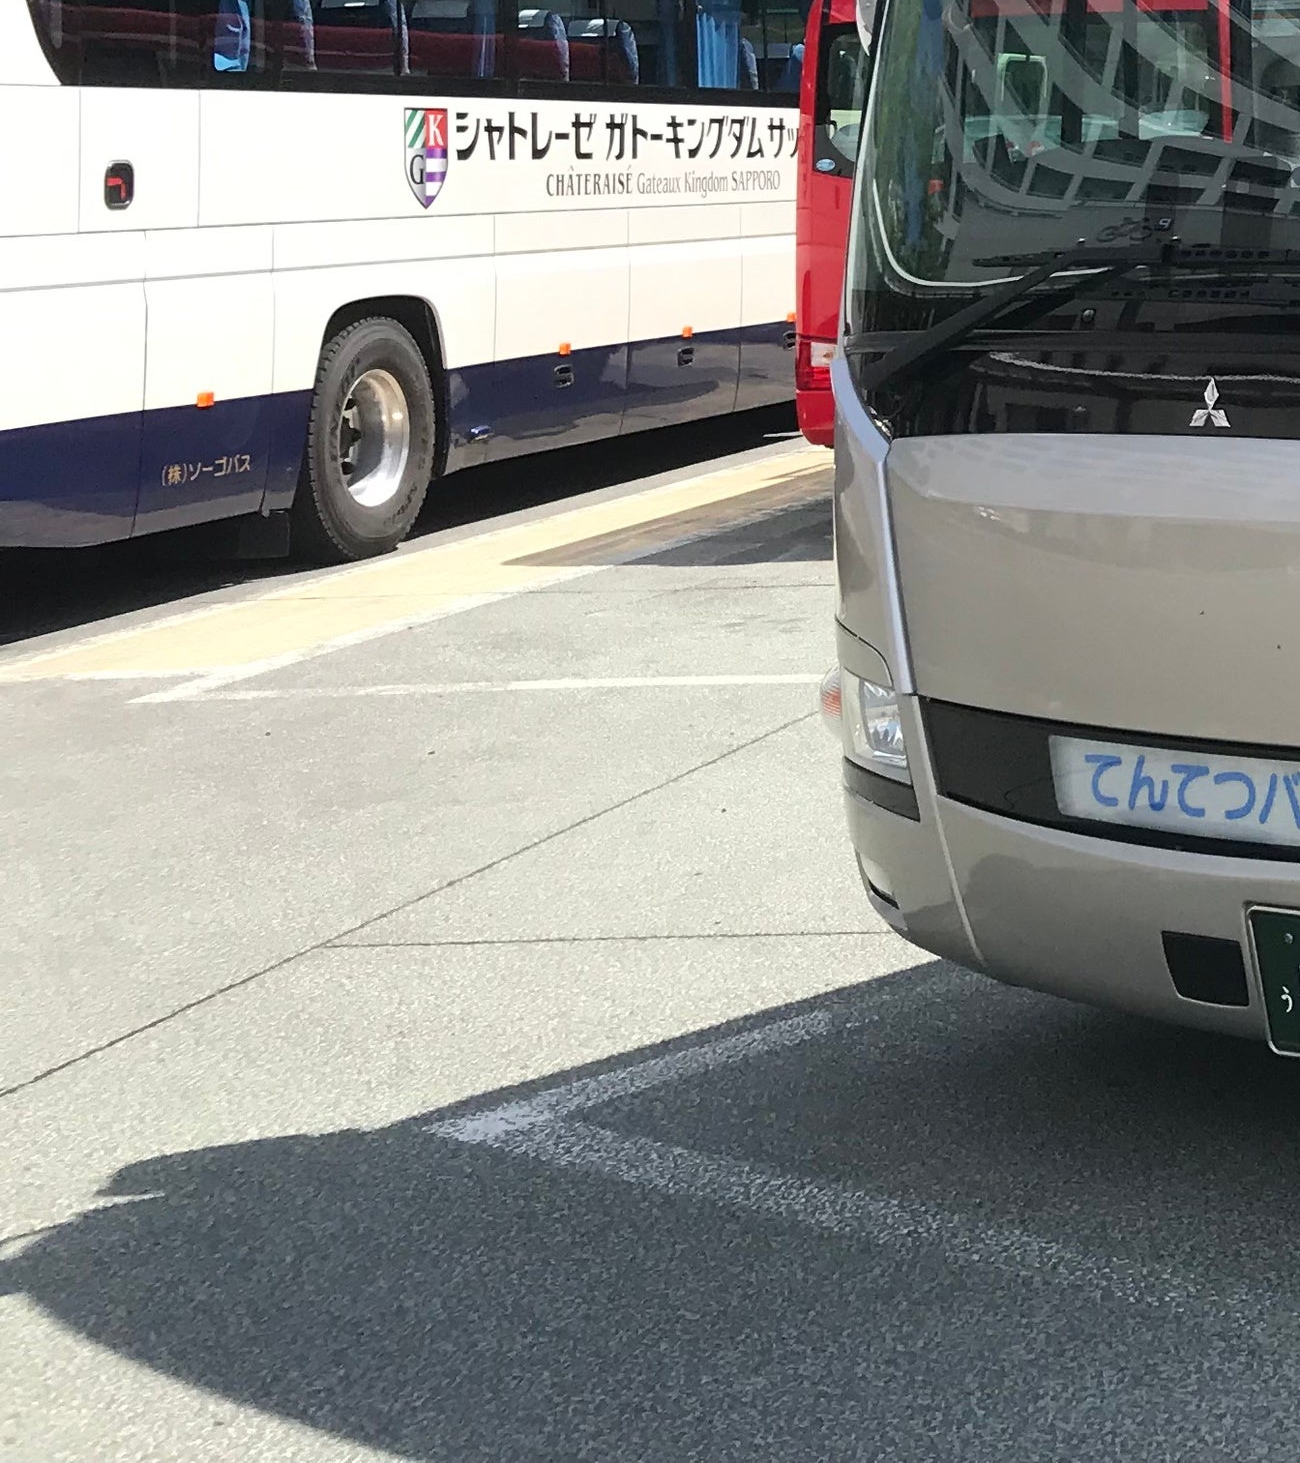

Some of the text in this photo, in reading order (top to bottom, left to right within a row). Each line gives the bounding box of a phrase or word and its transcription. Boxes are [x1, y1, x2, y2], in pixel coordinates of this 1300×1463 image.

[456, 111, 597, 160] シャトレーゼ
[546, 165, 781, 199] CHÂTERAISÉ Gateaux Kingdom SAPPORO
